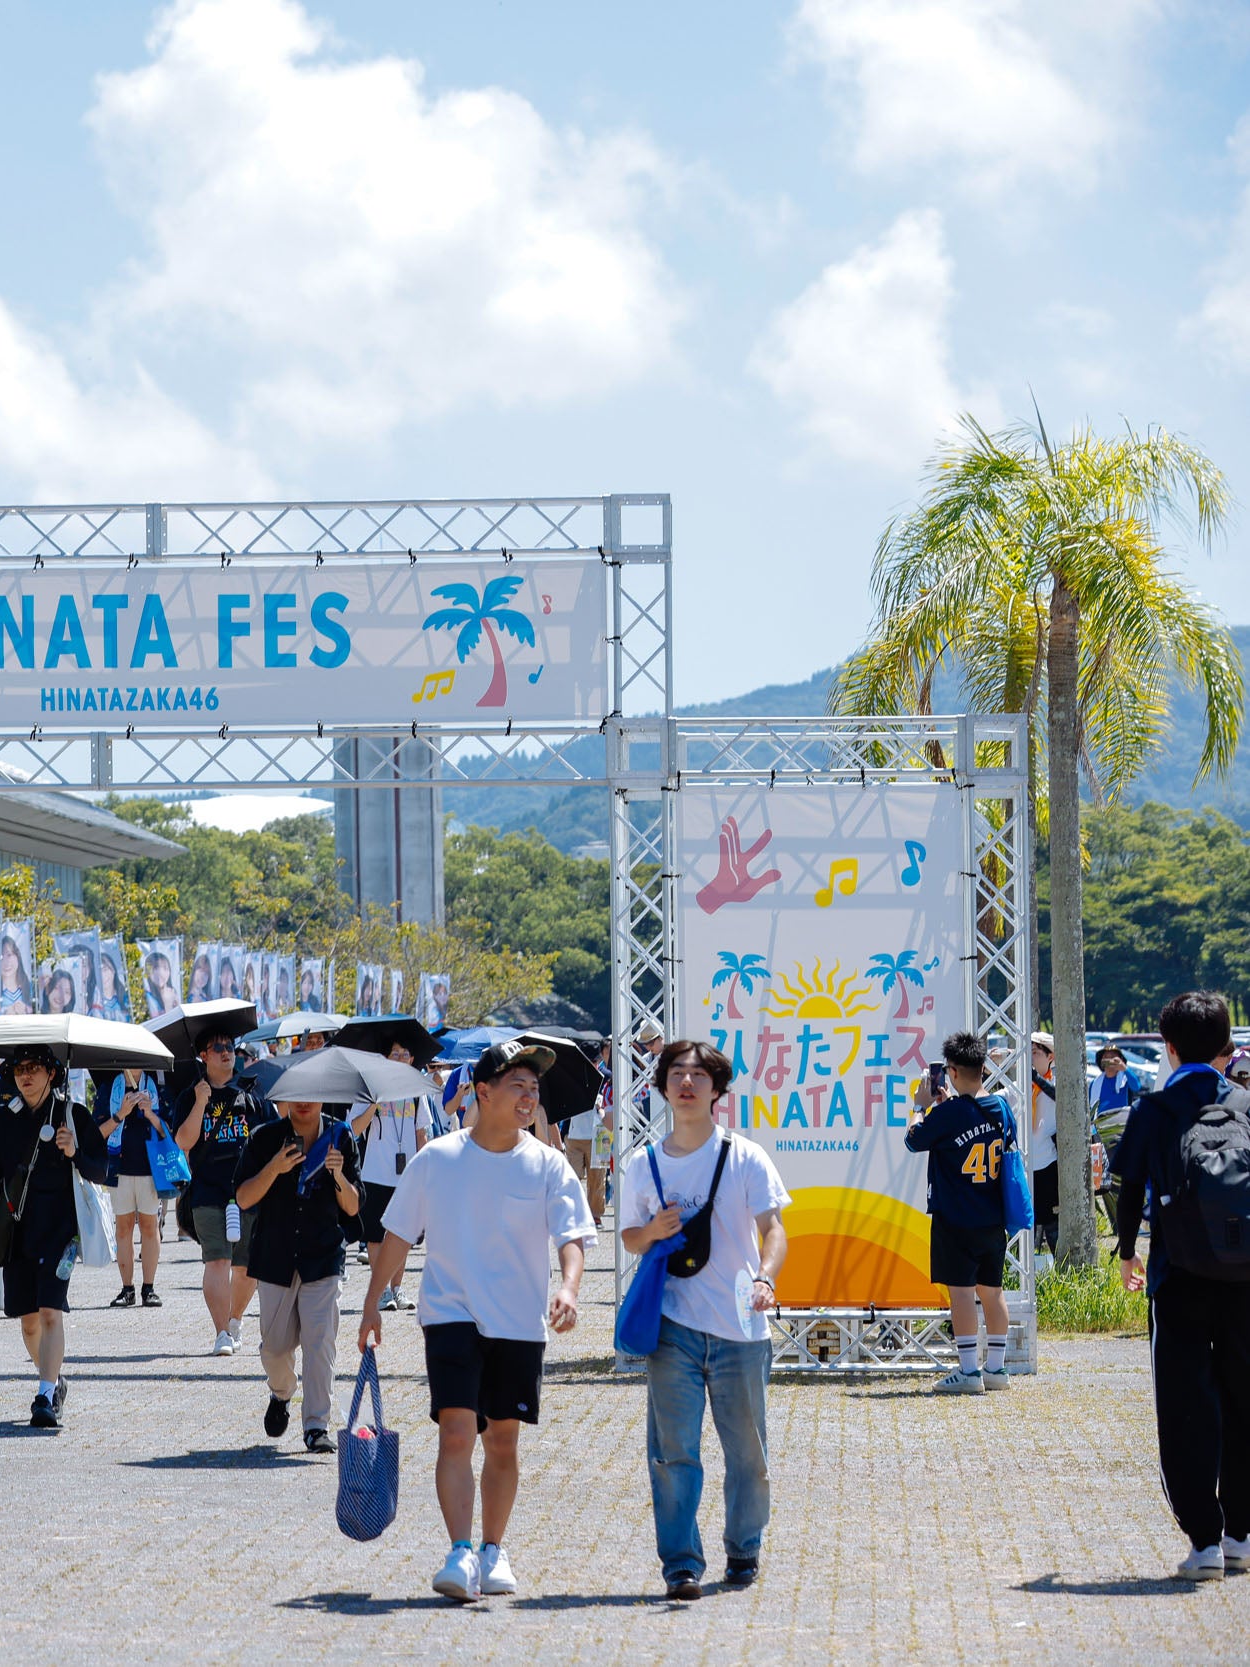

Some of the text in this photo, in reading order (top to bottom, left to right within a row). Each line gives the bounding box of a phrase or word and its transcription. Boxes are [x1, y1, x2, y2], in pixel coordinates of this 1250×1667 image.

[218, 592, 351, 668] FES
[41, 687, 219, 711] HINATAZAKA46
[712, 1081, 853, 1128] HINATA
[775, 1140, 859, 1152] HINATAZAKA46
[961, 1138, 1004, 1183] 46
